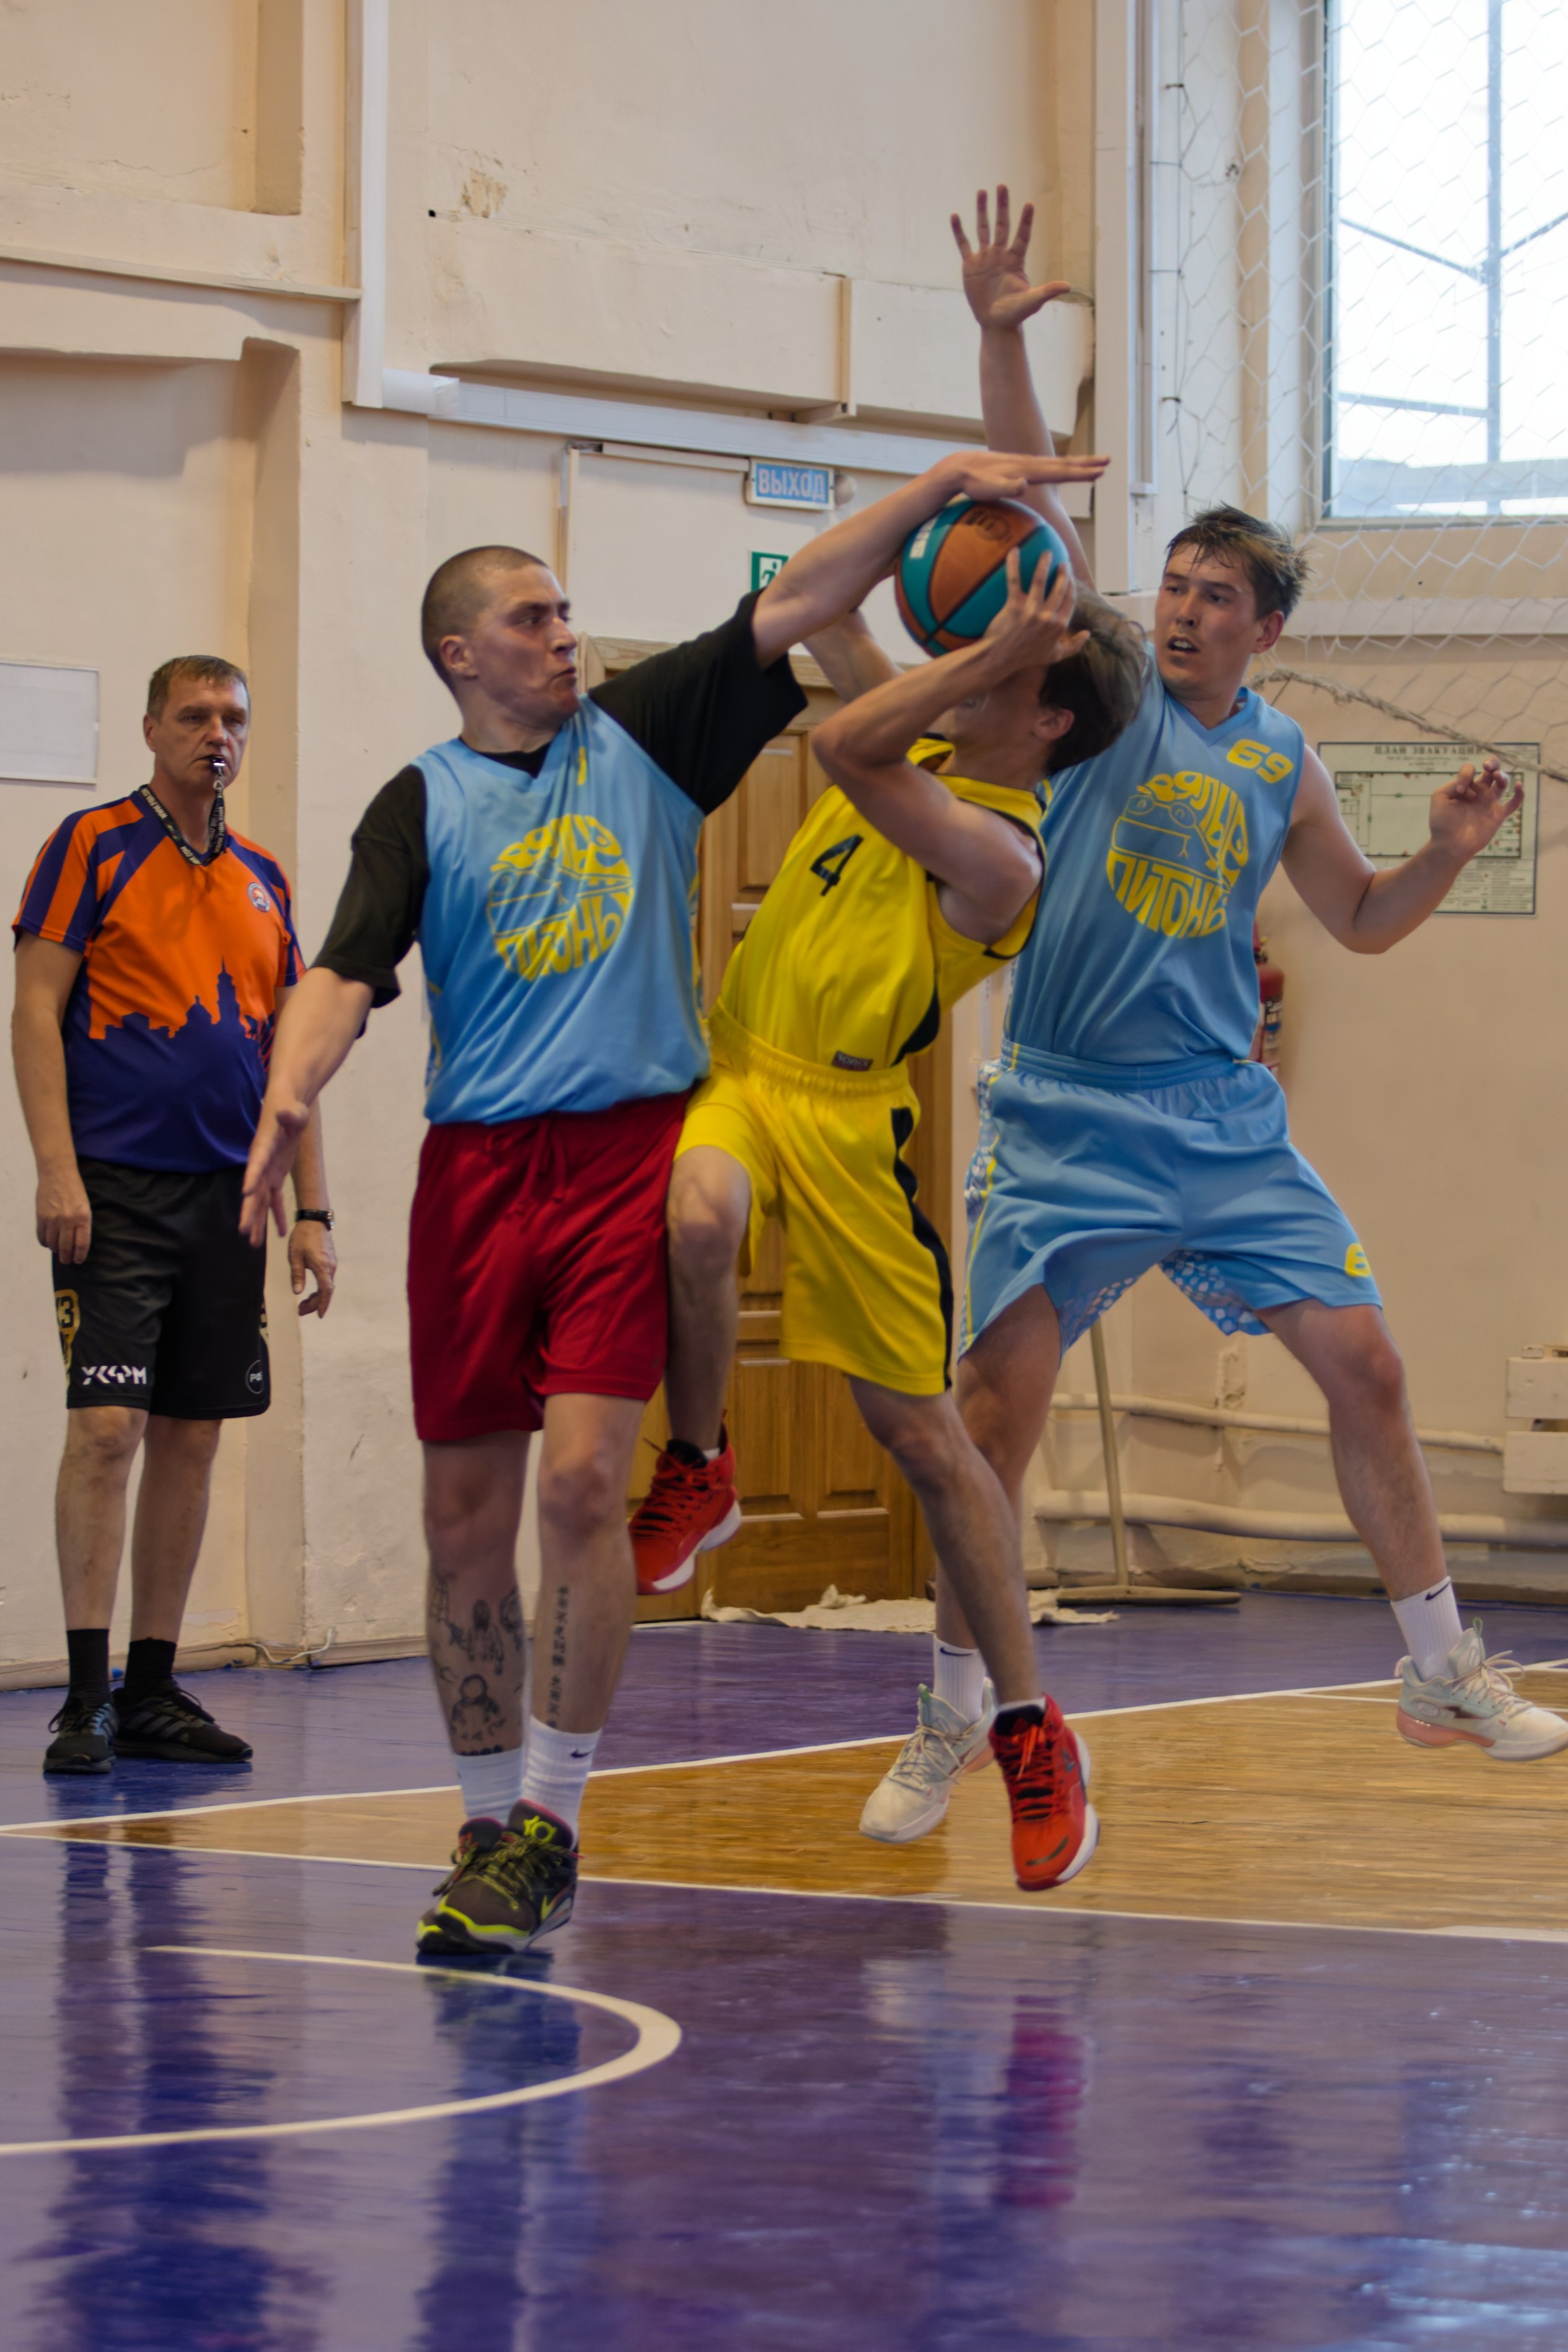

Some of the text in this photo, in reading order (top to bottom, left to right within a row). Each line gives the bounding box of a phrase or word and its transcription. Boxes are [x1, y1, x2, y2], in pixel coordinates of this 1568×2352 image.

[759, 469, 824, 500] ВЫХОД
[1227, 739, 1293, 783] 69
[1374, 746, 1407, 754] ПЛАН
[811, 835, 864, 896] 4
